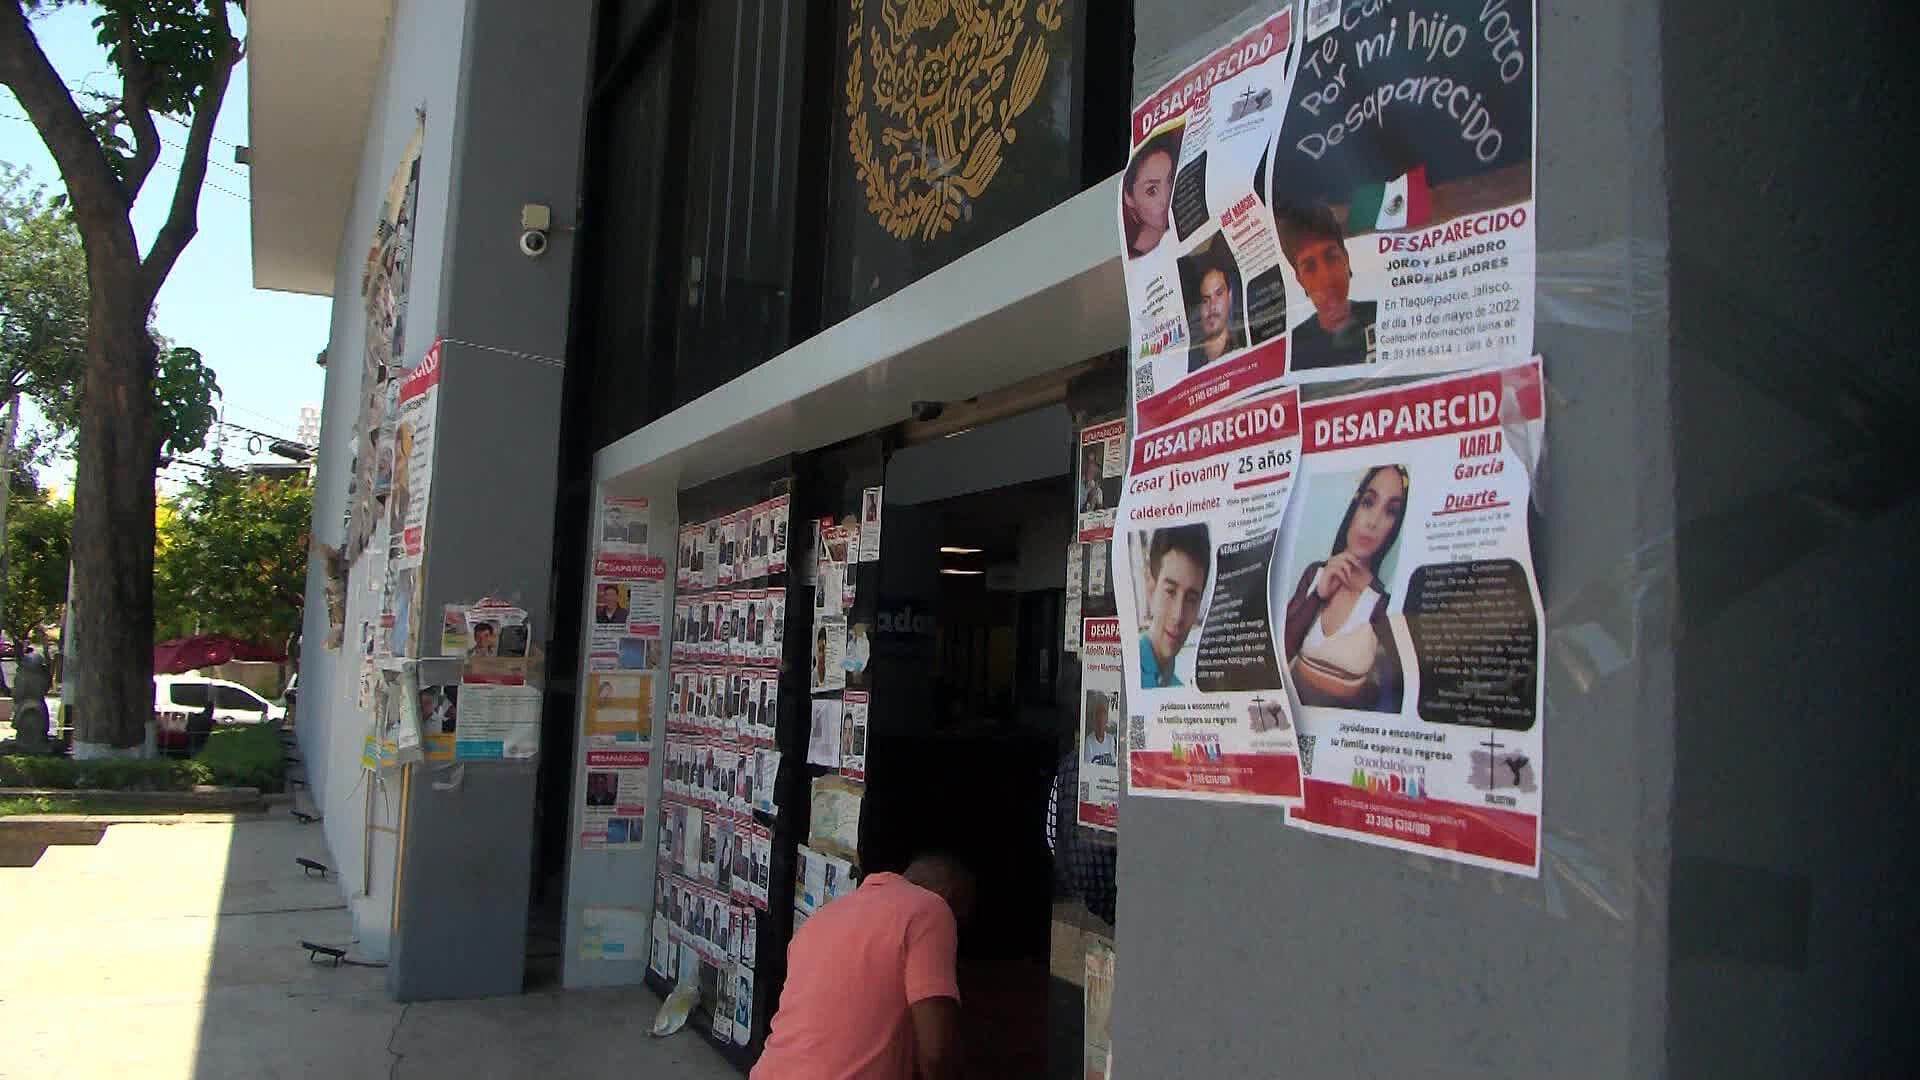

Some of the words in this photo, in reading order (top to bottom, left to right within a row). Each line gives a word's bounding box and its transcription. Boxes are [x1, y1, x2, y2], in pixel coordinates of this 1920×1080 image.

[1355, 17, 1398, 68] mi
[1407, 9, 1467, 63] hijo
[1302, 36, 1339, 78] Te
[1142, 34, 1274, 134] DESAPARECIDO
[1378, 206, 1527, 255] DESAPARECIDO
[1386, 258, 1430, 272] JORDY
[1434, 239, 1507, 266] ALEJANDRO
[1462, 256, 1509, 278] FLORES
[1381, 320, 1390, 330] el
[1411, 314, 1423, 327] 19
[1424, 313, 1440, 325] de
[1442, 309, 1473, 325] mayo
[1475, 307, 1487, 318] de
[1488, 299, 1521, 314] 2022
[1384, 298, 1397, 312] En
[1142, 403, 1285, 465] DESAPARECIDO
[1314, 390, 1503, 447] DESAPARECID
[1458, 431, 1503, 460] KARLA
[1168, 461, 1230, 492] Jiovanny
[1237, 455, 1254, 475] 25
[1257, 449, 1293, 471] años
[1129, 502, 1184, 521] Calderón
[1443, 489, 1498, 511] Duarte
[1340, 738, 1369, 750] familia
[1370, 743, 1401, 755] espera
[1415, 749, 1454, 761] regreso
